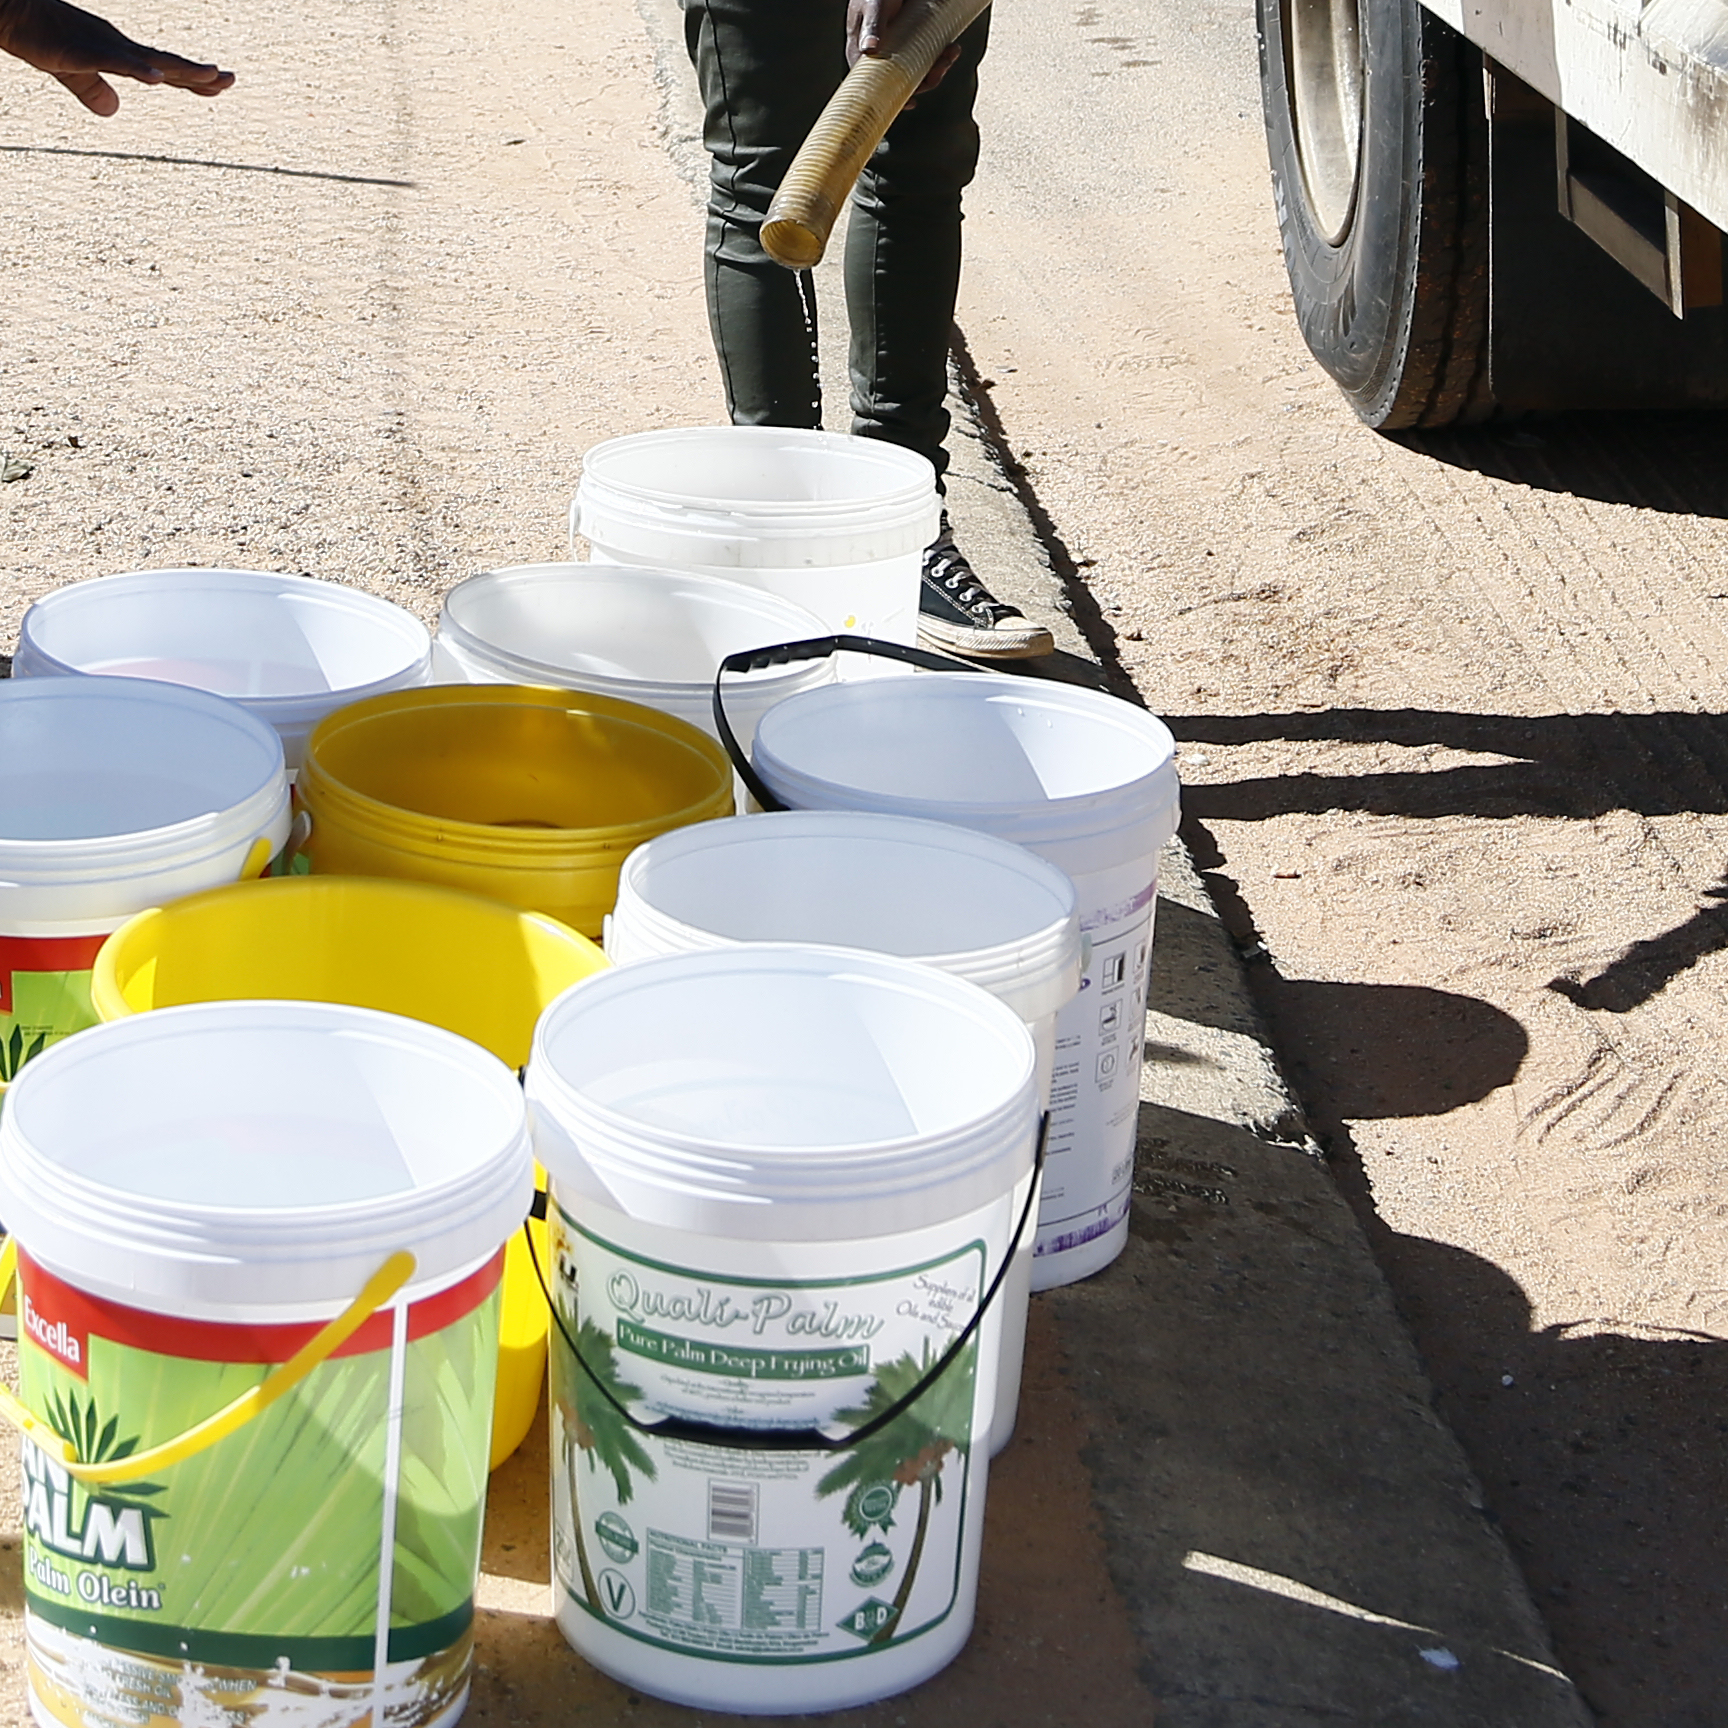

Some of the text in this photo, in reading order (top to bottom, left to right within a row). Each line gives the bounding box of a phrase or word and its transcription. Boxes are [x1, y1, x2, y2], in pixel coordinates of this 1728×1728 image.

[24, 1294, 81, 1363] Excella
[619, 1323, 869, 1379] Pure Palm Deep Frying Oil
[29, 1544, 162, 1610] Palm Olein
[605, 1574, 627, 1613] V
